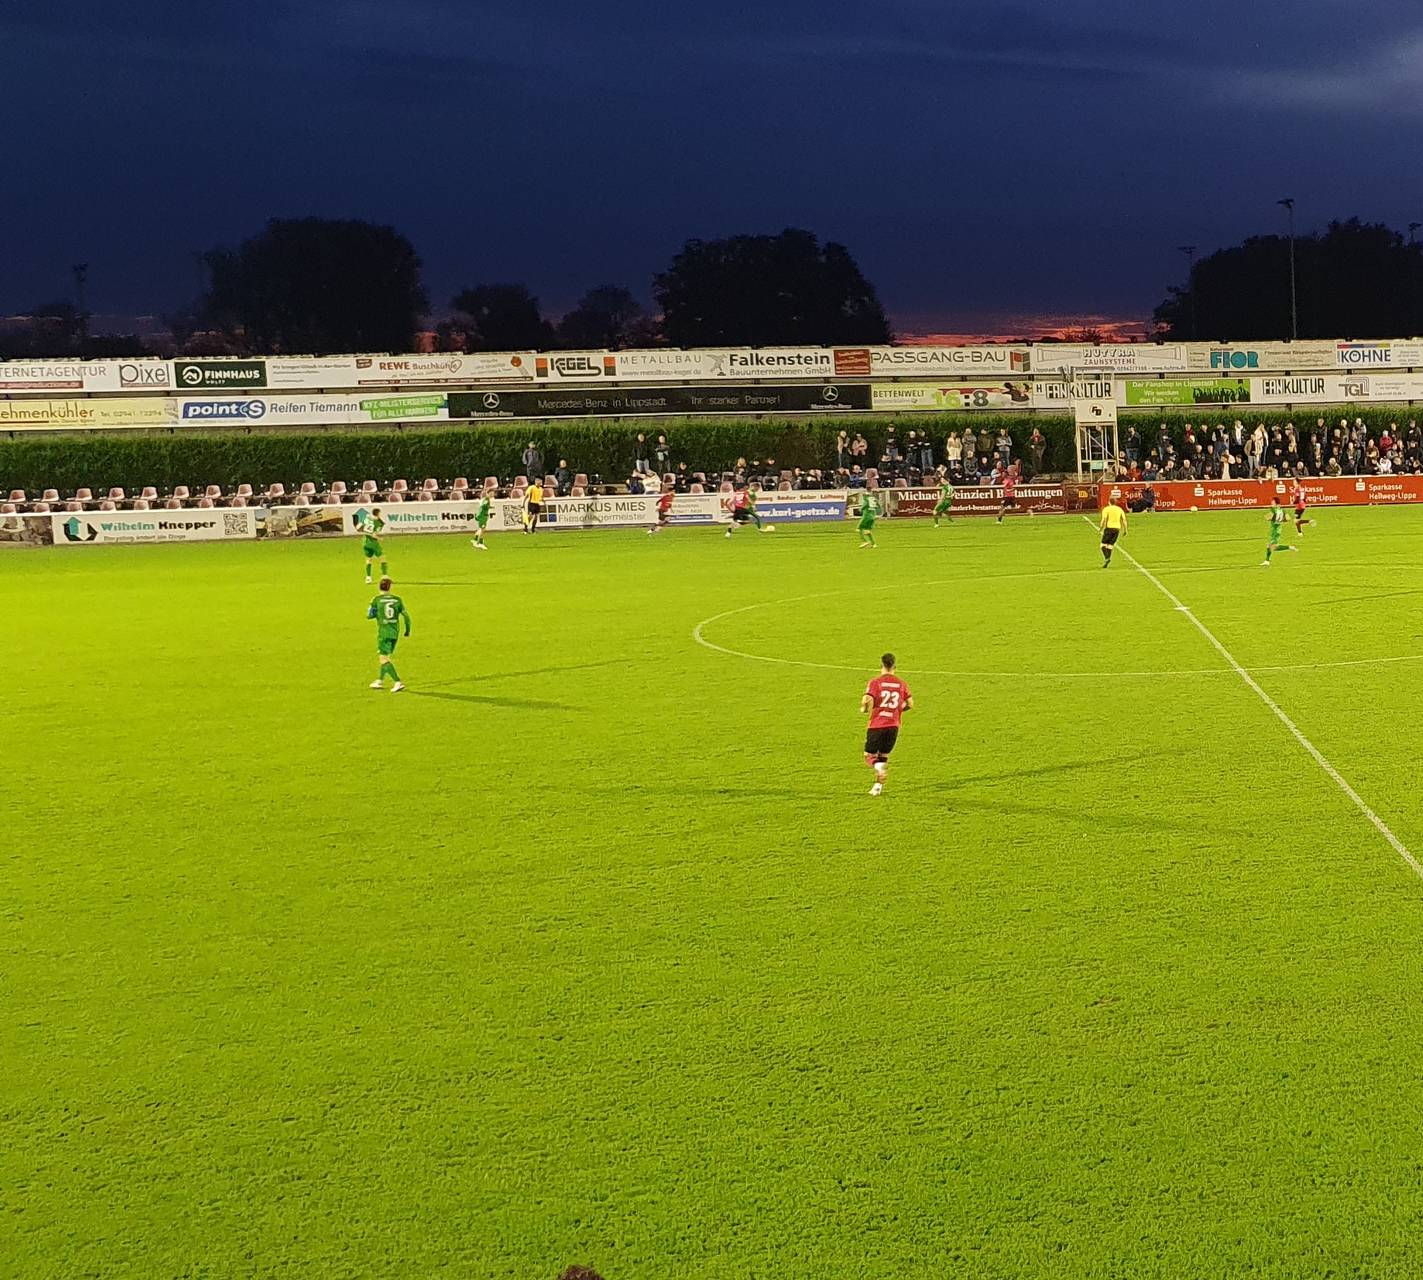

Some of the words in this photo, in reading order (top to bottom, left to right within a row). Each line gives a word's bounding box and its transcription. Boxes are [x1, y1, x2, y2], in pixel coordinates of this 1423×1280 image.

[620, 355, 702, 365] METALLBAU
[729, 352, 830, 366] Falkenstein
[870, 350, 1006, 364] PASSGANG-BAU
[379, 362, 410, 371] REWE
[729, 367, 802, 376] Bauunternehmen
[805, 366, 832, 375] GmbH
[204, 370, 260, 380] FINNHAUS
[1263, 378, 1325, 395] FANKULTUR
[873, 390, 925, 399] BETTENWELT
[187, 402, 238, 418] point
[270, 401, 306, 414] Reifen
[309, 401, 358, 413] Tiemann
[1207, 488, 1243, 497] Sparkasse
[1368, 483, 1403, 491] Sparkasse
[898, 490, 942, 501] Michael
[952, 489, 994, 500] einzierl
[1369, 491, 1417, 500] Hellweg-Lippe
[558, 501, 612, 513] MARKUS
[615, 501, 646, 512] MIES
[1208, 497, 1258, 507] Hellweg-Lippe
[387, 512, 438, 523] Wilhelm
[101, 522, 155, 532] Wilhelm
[158, 520, 217, 531] Knepper
[384, 602, 395, 619] 6
[879, 690, 900, 709] 23
